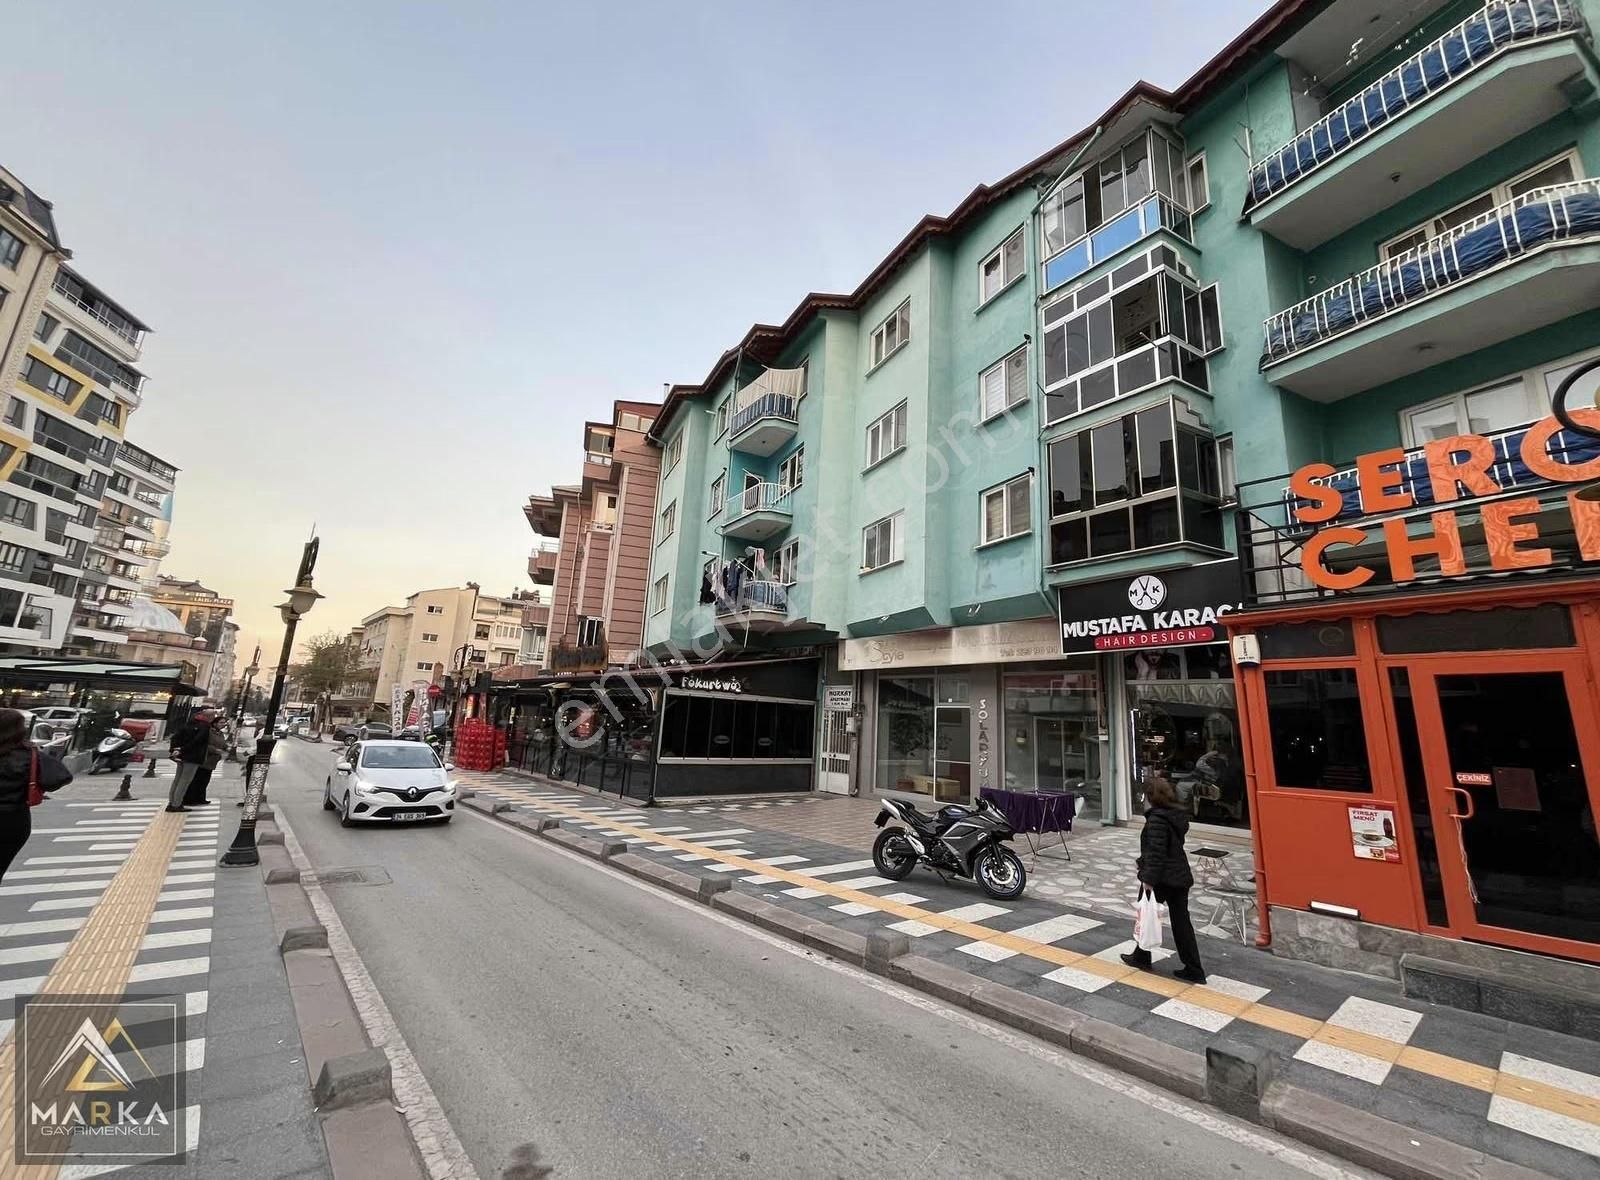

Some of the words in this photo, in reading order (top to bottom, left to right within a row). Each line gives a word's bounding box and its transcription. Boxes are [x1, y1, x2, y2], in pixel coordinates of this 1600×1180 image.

[1063, 614, 1148, 639] MUSTAFA
[1103, 635, 1136, 647] HAIR
[1141, 630, 1197, 644] DESIGN
[1456, 773, 1489, 783] ÇEKİNİZ
